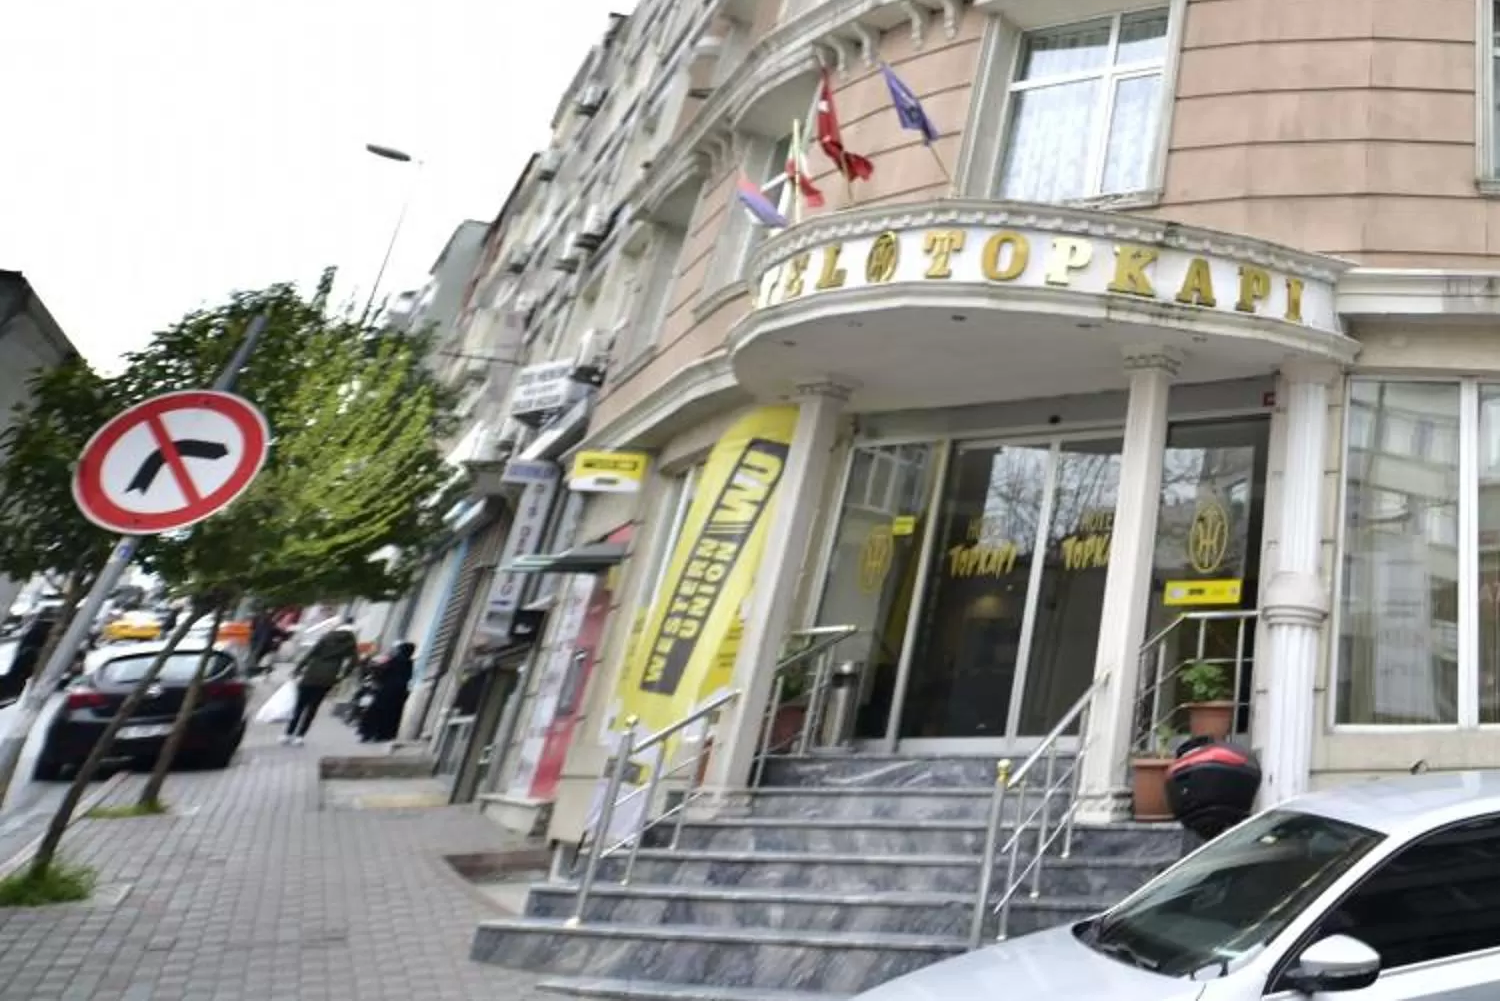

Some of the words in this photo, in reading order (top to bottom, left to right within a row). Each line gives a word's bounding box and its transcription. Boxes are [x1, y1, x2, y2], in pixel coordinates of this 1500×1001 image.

[924, 229, 1304, 322] TOPKAPI
[713, 449, 782, 525] WU
[643, 538, 717, 683] WESTERN
[679, 541, 738, 639] UNION
